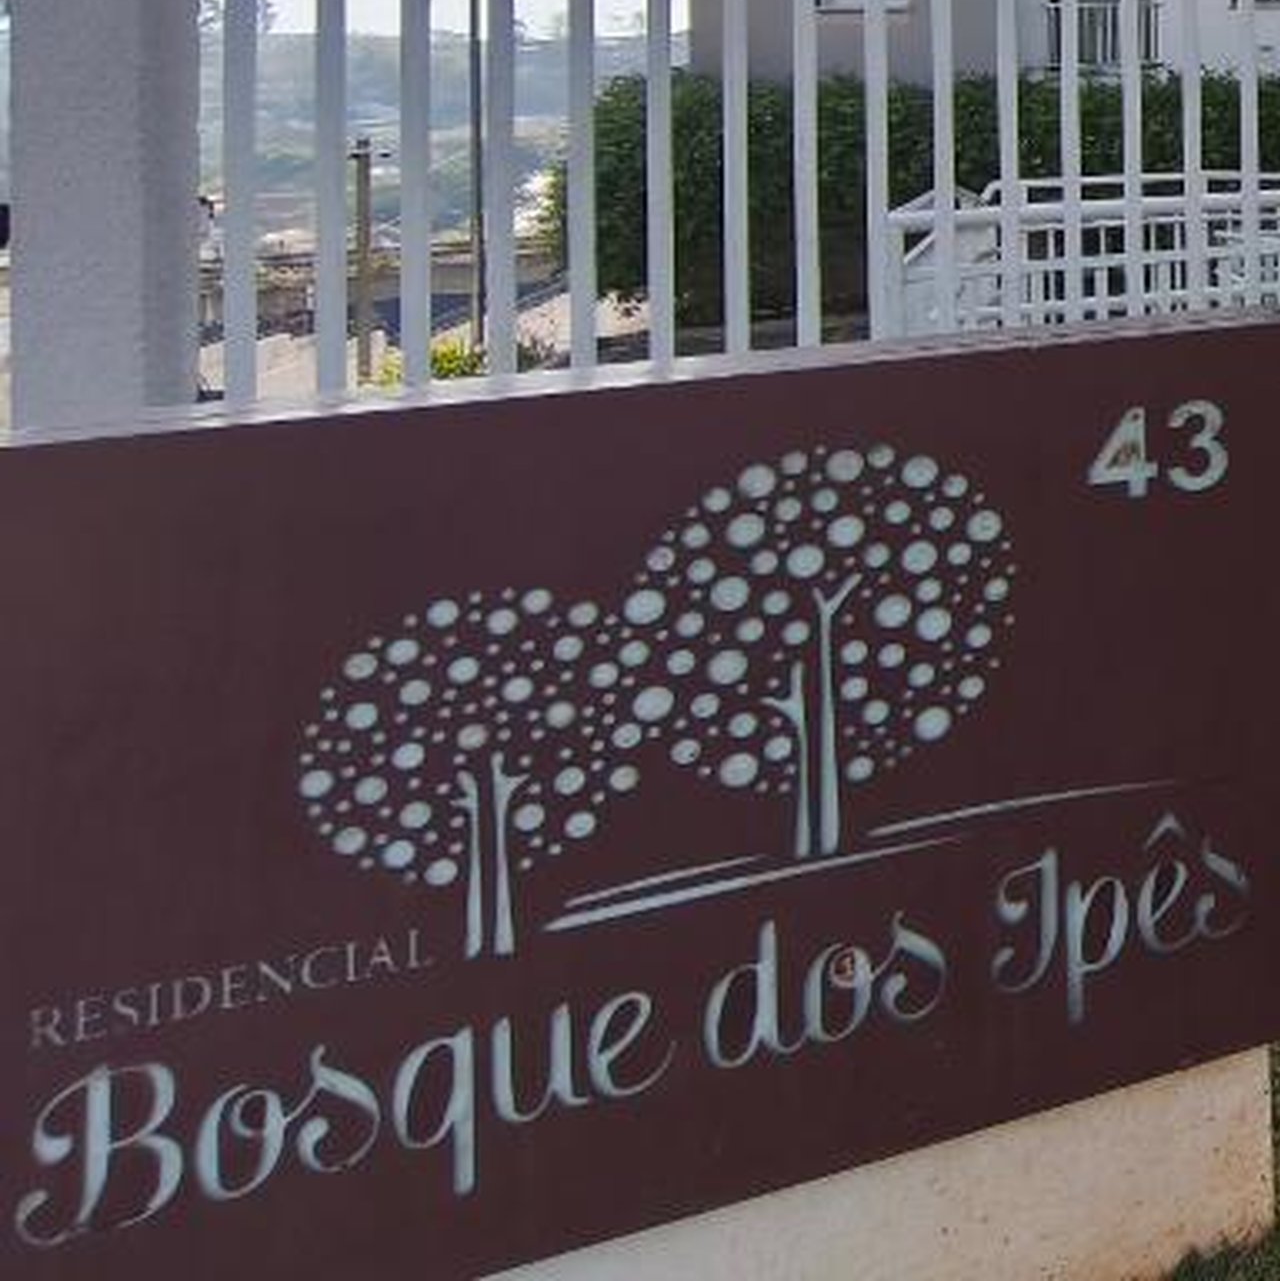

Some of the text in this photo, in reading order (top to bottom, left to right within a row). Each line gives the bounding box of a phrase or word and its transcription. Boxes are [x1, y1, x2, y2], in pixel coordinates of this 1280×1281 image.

[1087, 399, 1229, 498] 43
[15, 811, 1250, 1247] Bosque dos Ipês
[28, 927, 436, 1049] RESIDENCIAL
